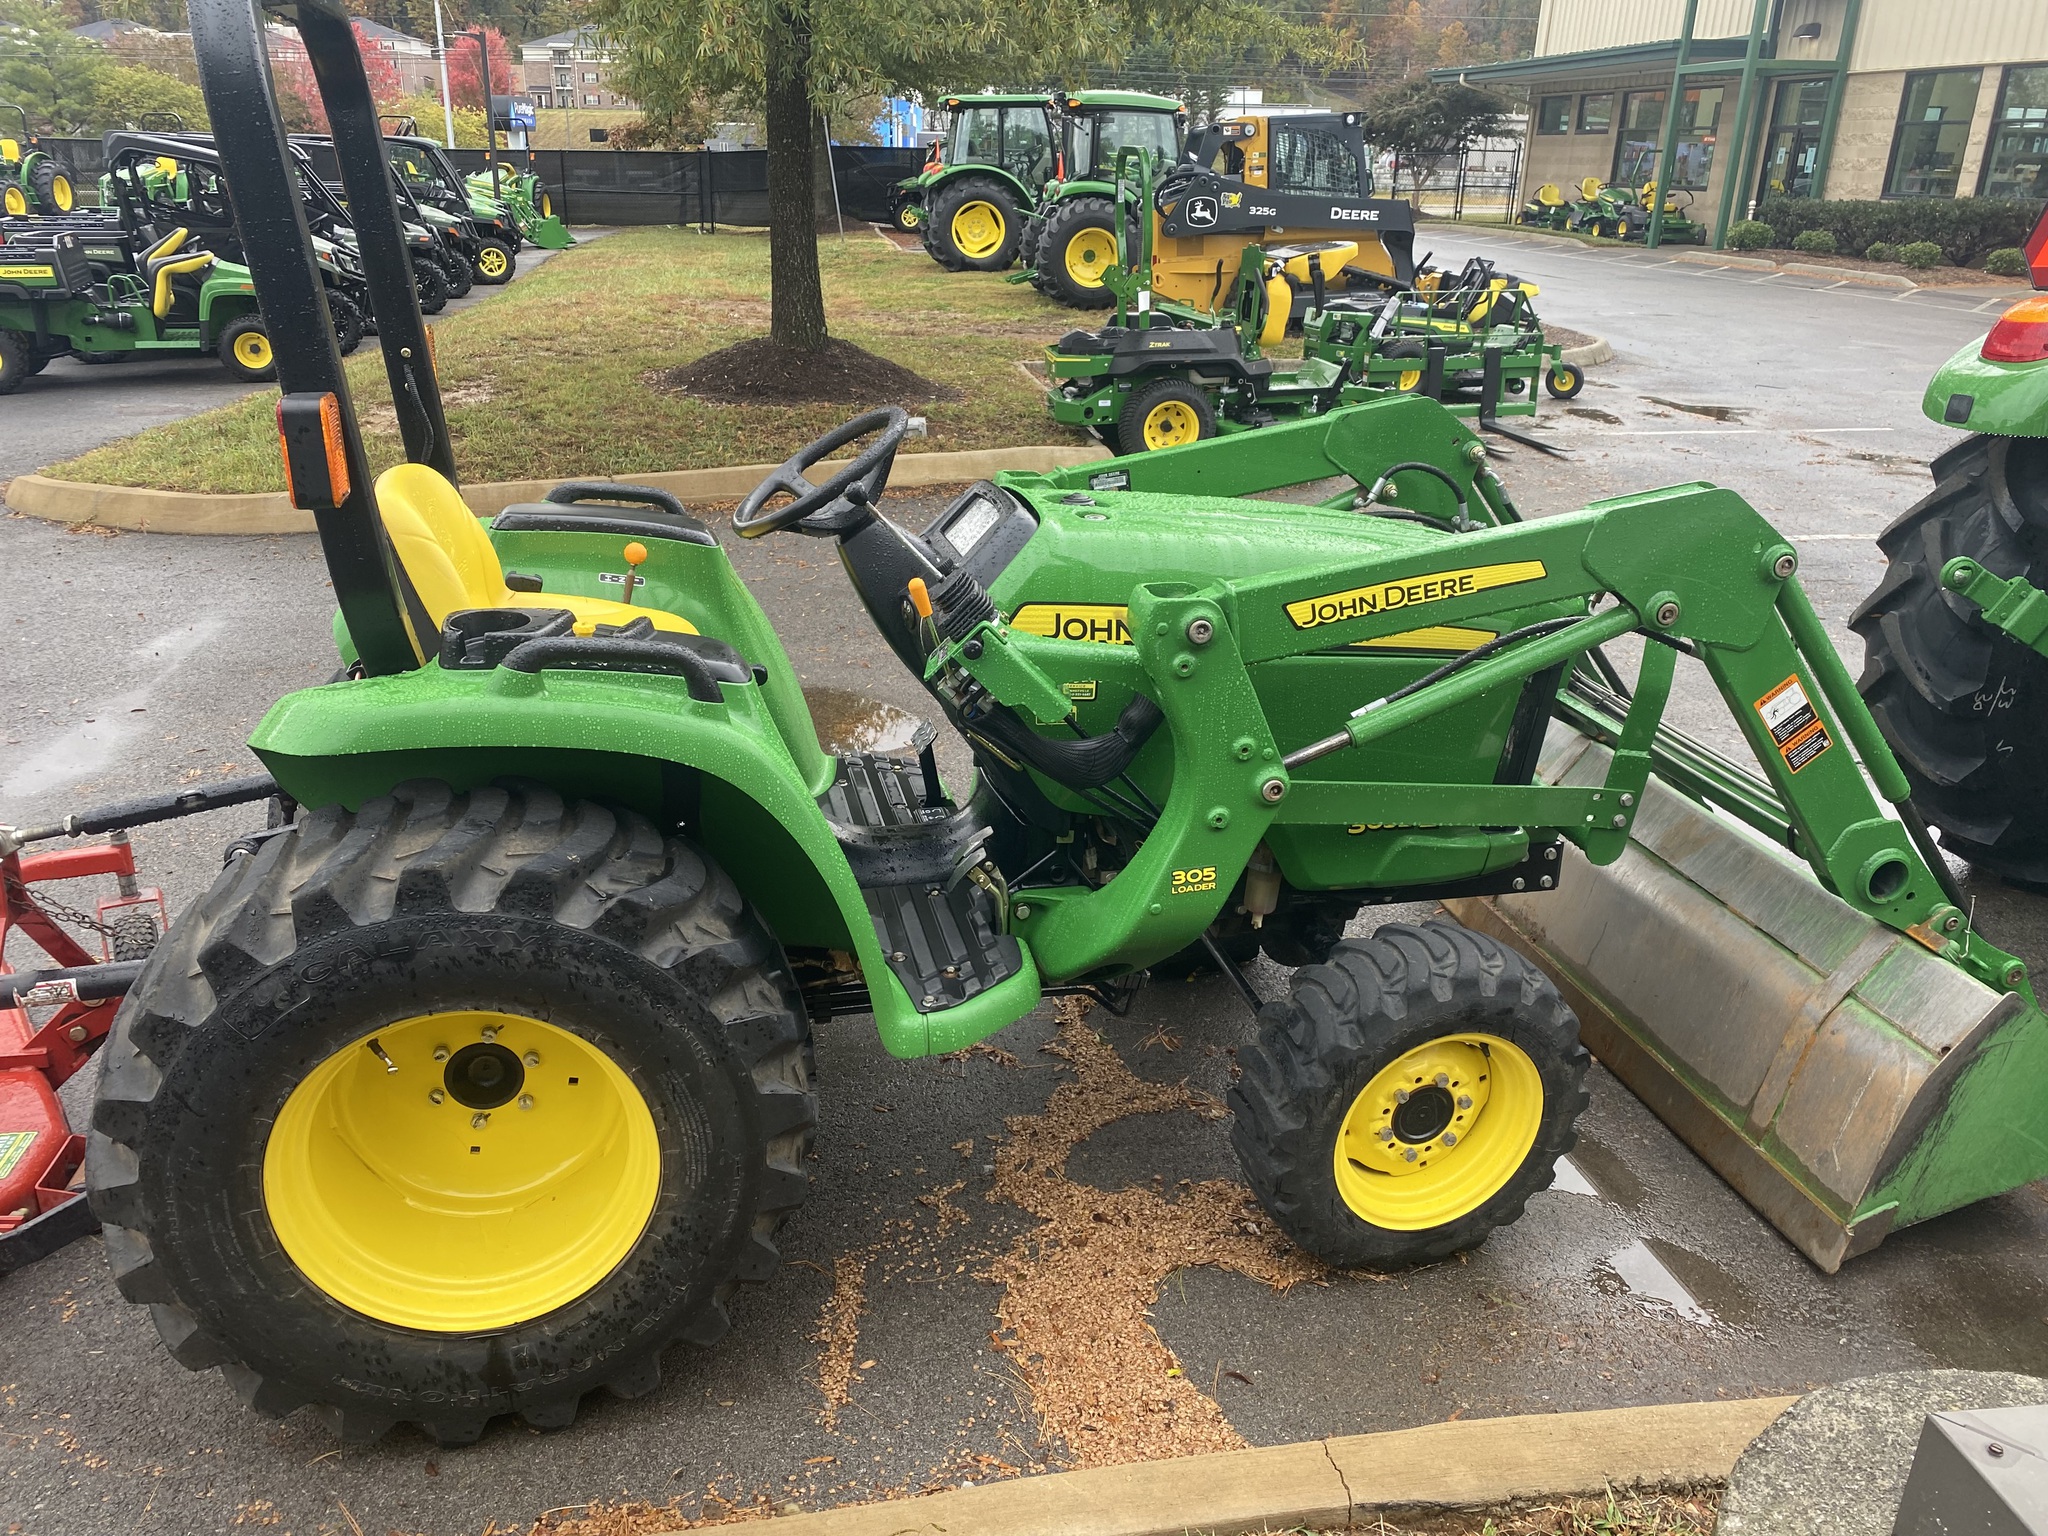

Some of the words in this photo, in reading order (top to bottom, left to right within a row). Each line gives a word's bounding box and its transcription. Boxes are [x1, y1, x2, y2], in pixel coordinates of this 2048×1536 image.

[1249, 206, 1277, 216] 325G
[1330, 206, 1380, 221] DEERE
[1148, 341, 1171, 349] ZTRAK
[1301, 593, 1378, 626] JOHN
[1384, 574, 1475, 611] DEERE
[1041, 612, 1133, 641] JOHN
[1766, 679, 1793, 701] WARNING
[1792, 725, 1819, 747] WARNING
[1171, 866, 1217, 885] 305
[1171, 882, 1217, 896] LOADER
